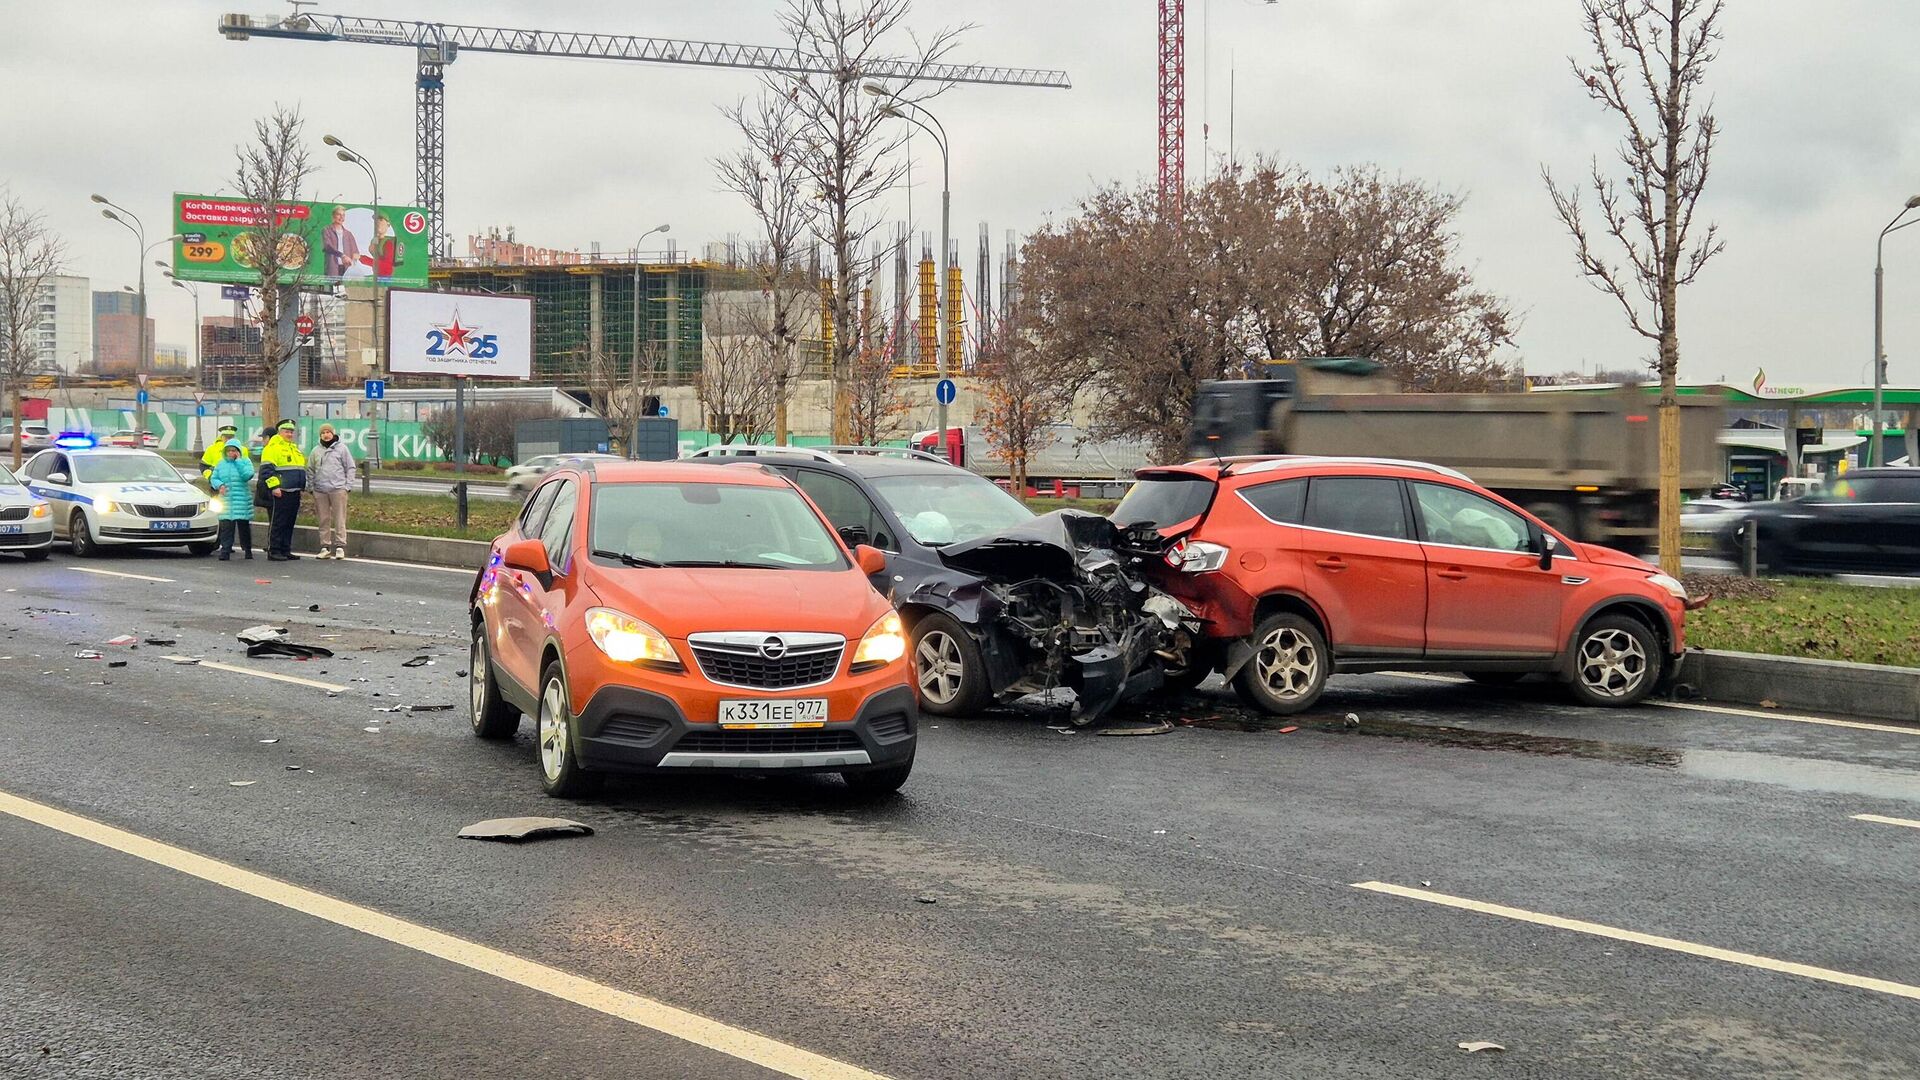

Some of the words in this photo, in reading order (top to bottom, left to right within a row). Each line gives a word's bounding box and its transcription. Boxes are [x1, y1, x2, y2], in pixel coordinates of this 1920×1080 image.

[185, 202, 212, 211] Когда
[185, 212, 228, 222] доставка
[189, 246, 213, 258] 299
[725, 703, 793, 720] К331ЕЕ
[797, 701, 822, 715] 977
